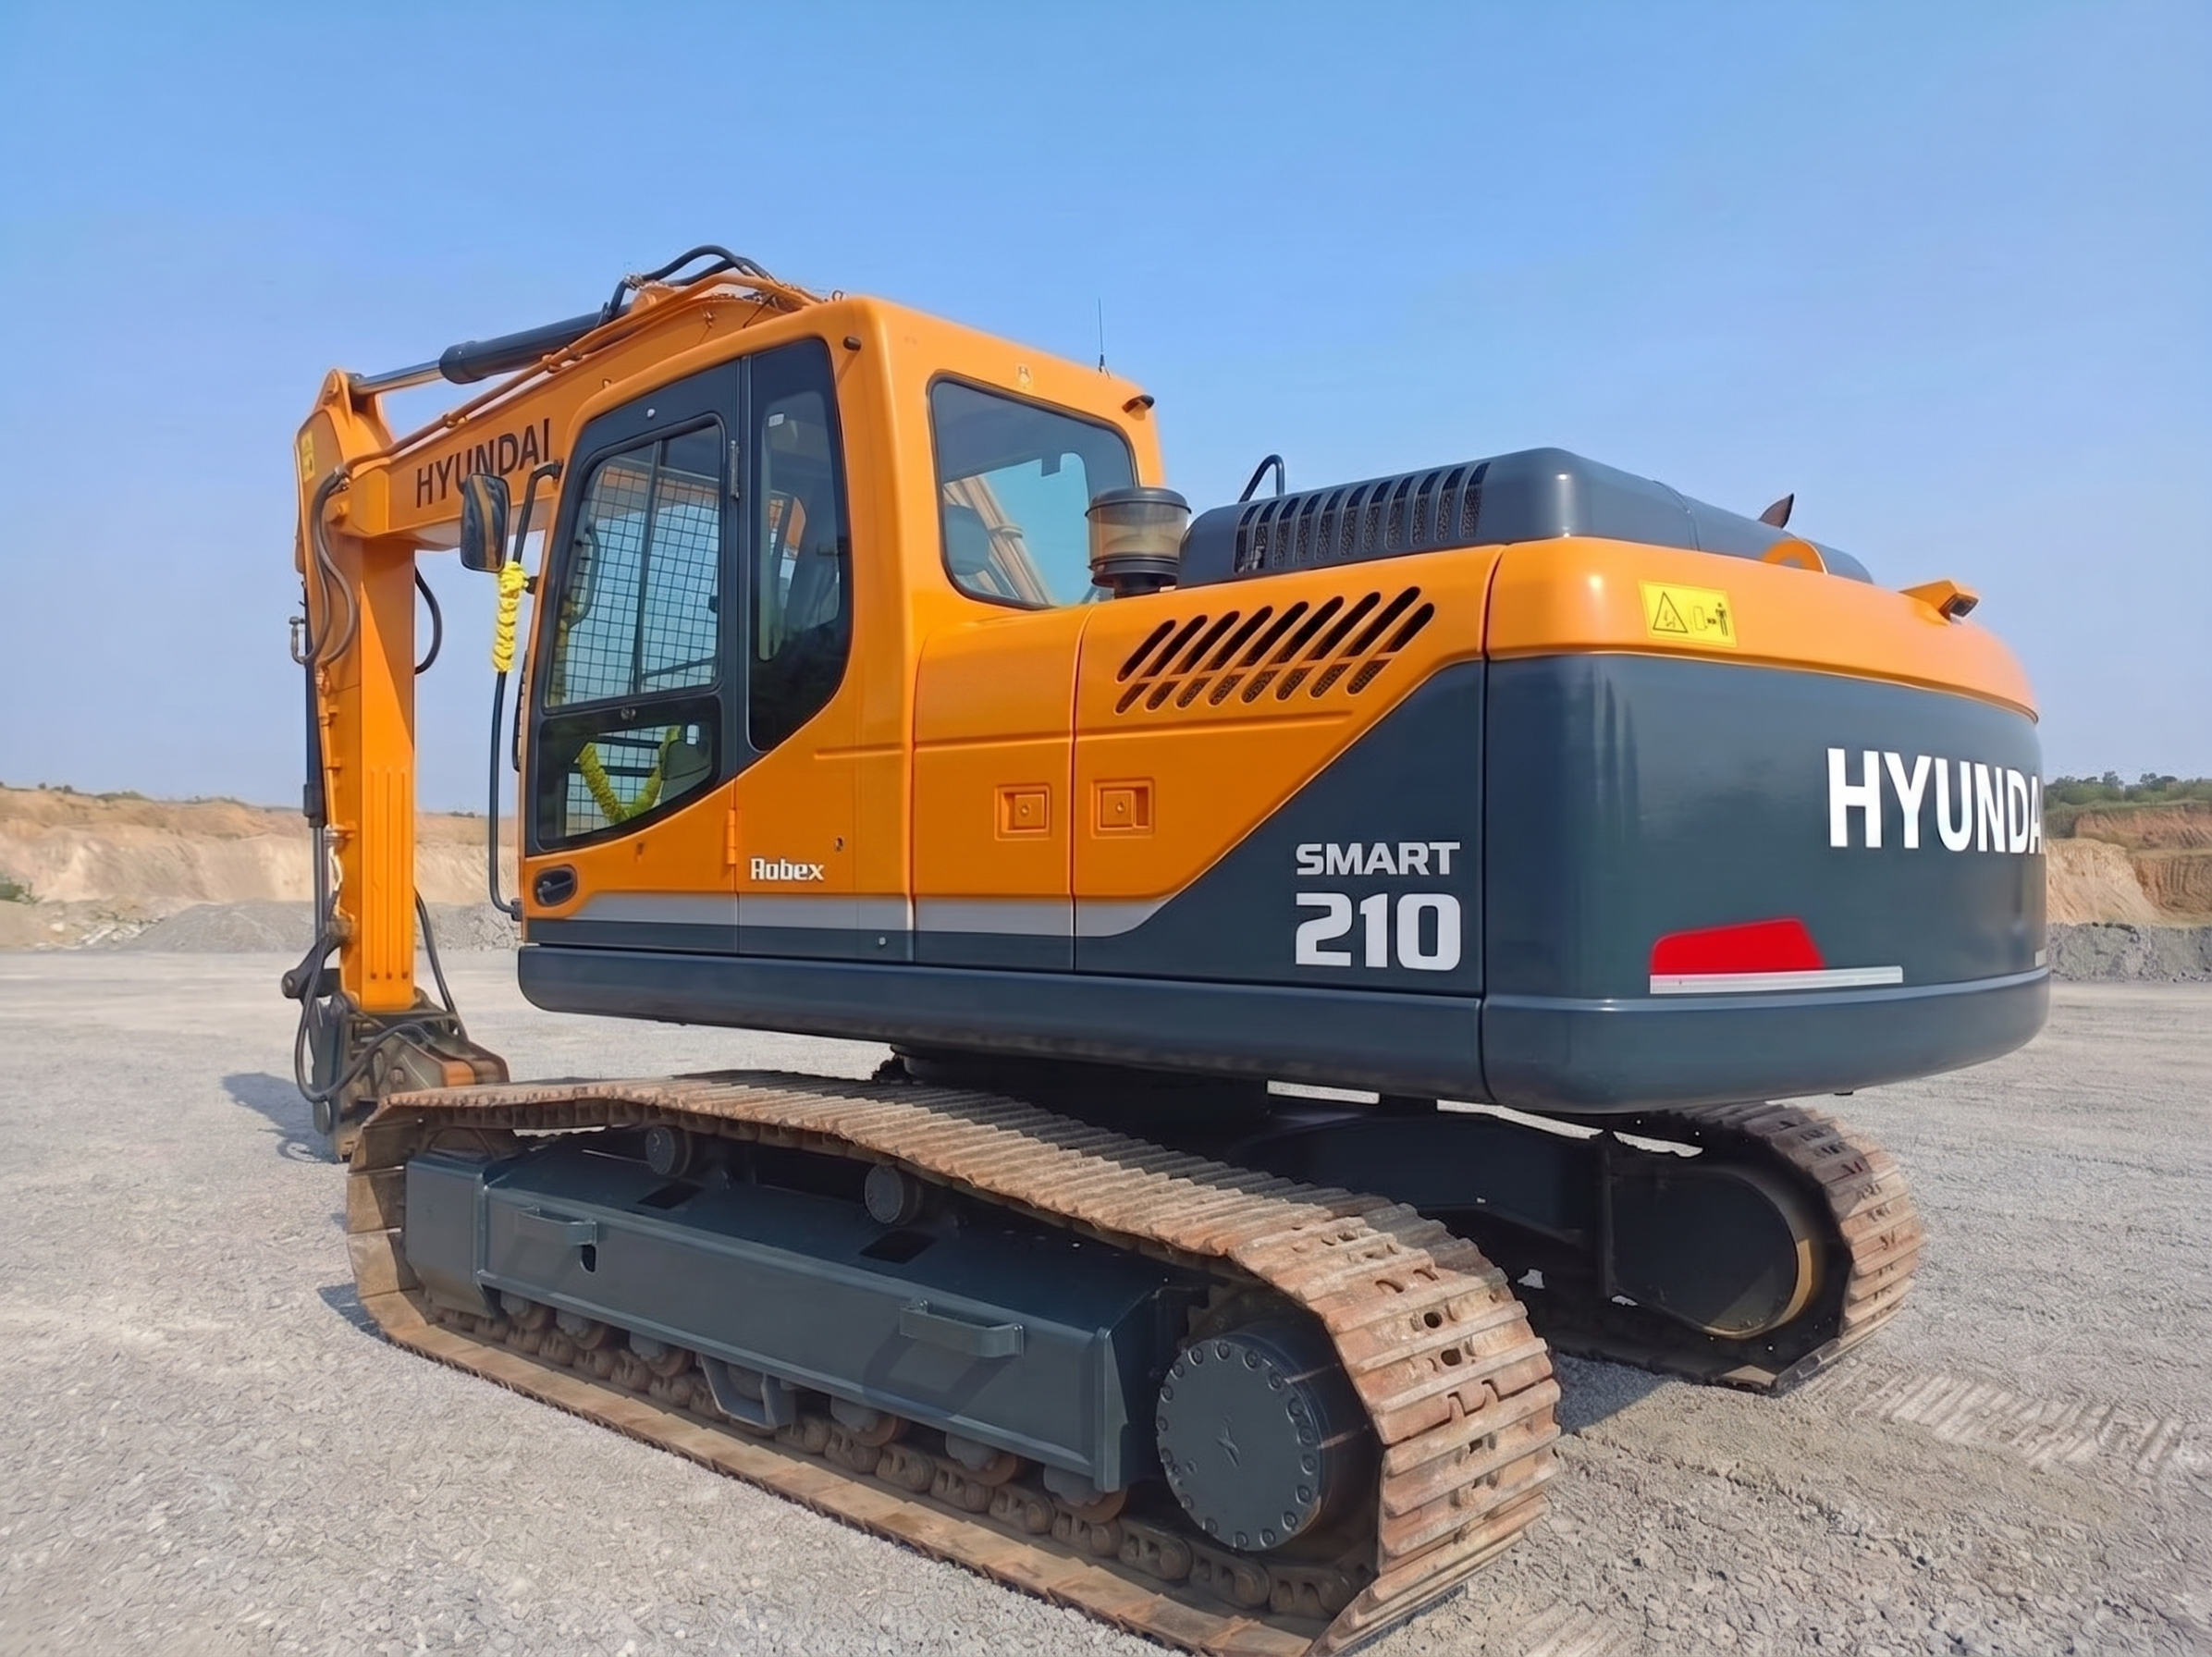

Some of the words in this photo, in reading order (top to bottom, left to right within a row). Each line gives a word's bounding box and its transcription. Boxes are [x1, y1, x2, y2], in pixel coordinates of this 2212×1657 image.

[416, 418, 550, 509] HYUNDAI
[1827, 747, 2045, 854] HYUNDA
[750, 857, 825, 881] Robex
[1296, 841, 1461, 876] SMART
[1296, 892, 1461, 972] 210
